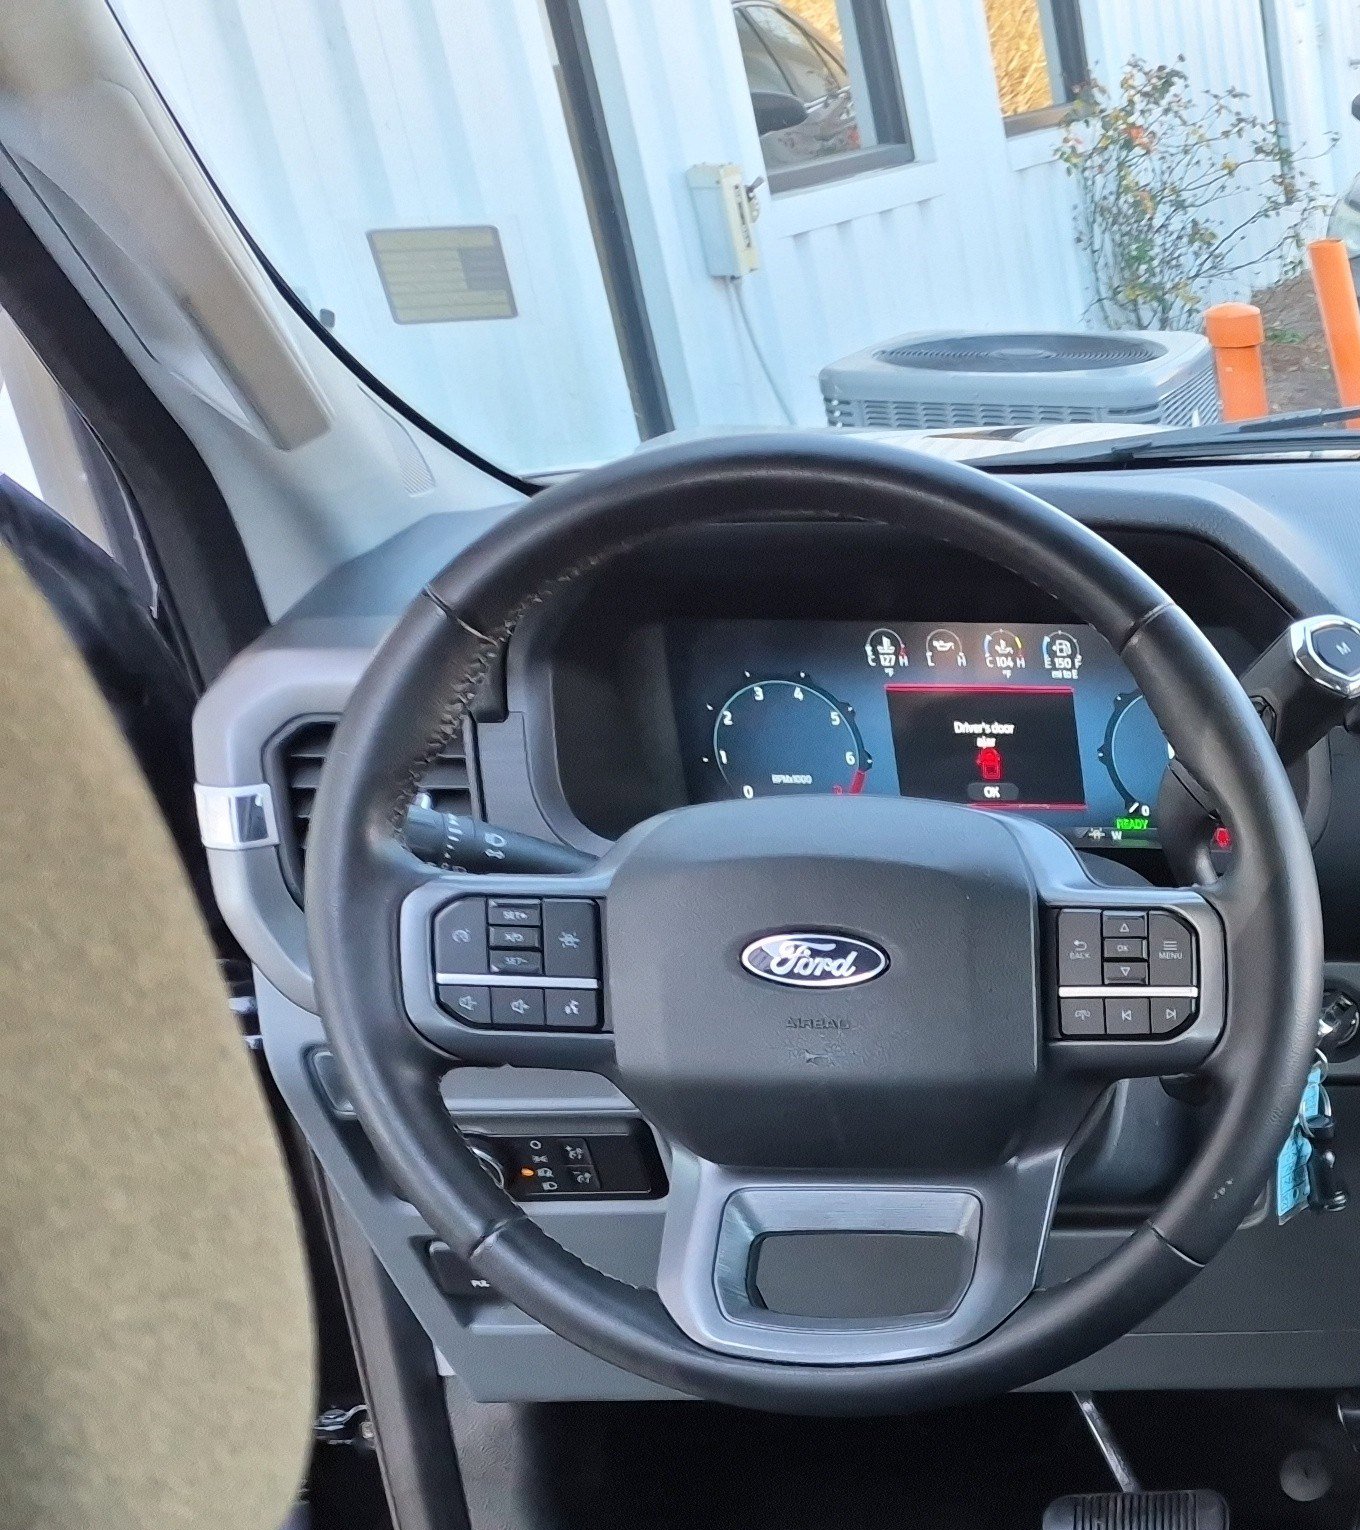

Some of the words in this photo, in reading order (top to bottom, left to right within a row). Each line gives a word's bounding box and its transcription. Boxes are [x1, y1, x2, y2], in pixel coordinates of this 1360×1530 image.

[1336, 642, 1351, 655] M
[996, 656, 1014, 667] 104
[1017, 657, 1025, 668] H
[1044, 657, 1052, 668] E
[1054, 657, 1071, 669] 150
[754, 686, 764, 701] 3
[794, 686, 804, 701] 4
[723, 710, 733, 725] 2
[830, 711, 841, 725] 5
[953, 721, 991, 734] Driver's
[991, 721, 1015, 734] door
[719, 749, 727, 764] 1
[845, 752, 855, 765] 6
[743, 785, 754, 799] 0
[983, 786, 1000, 798] OK
[1141, 805, 1150, 816] 0
[1116, 818, 1149, 829] READY
[1111, 831, 1122, 840] W
[1117, 944, 1129, 952] OK
[769, 940, 859, 977] Ford
[1159, 952, 1183, 960] MENU
